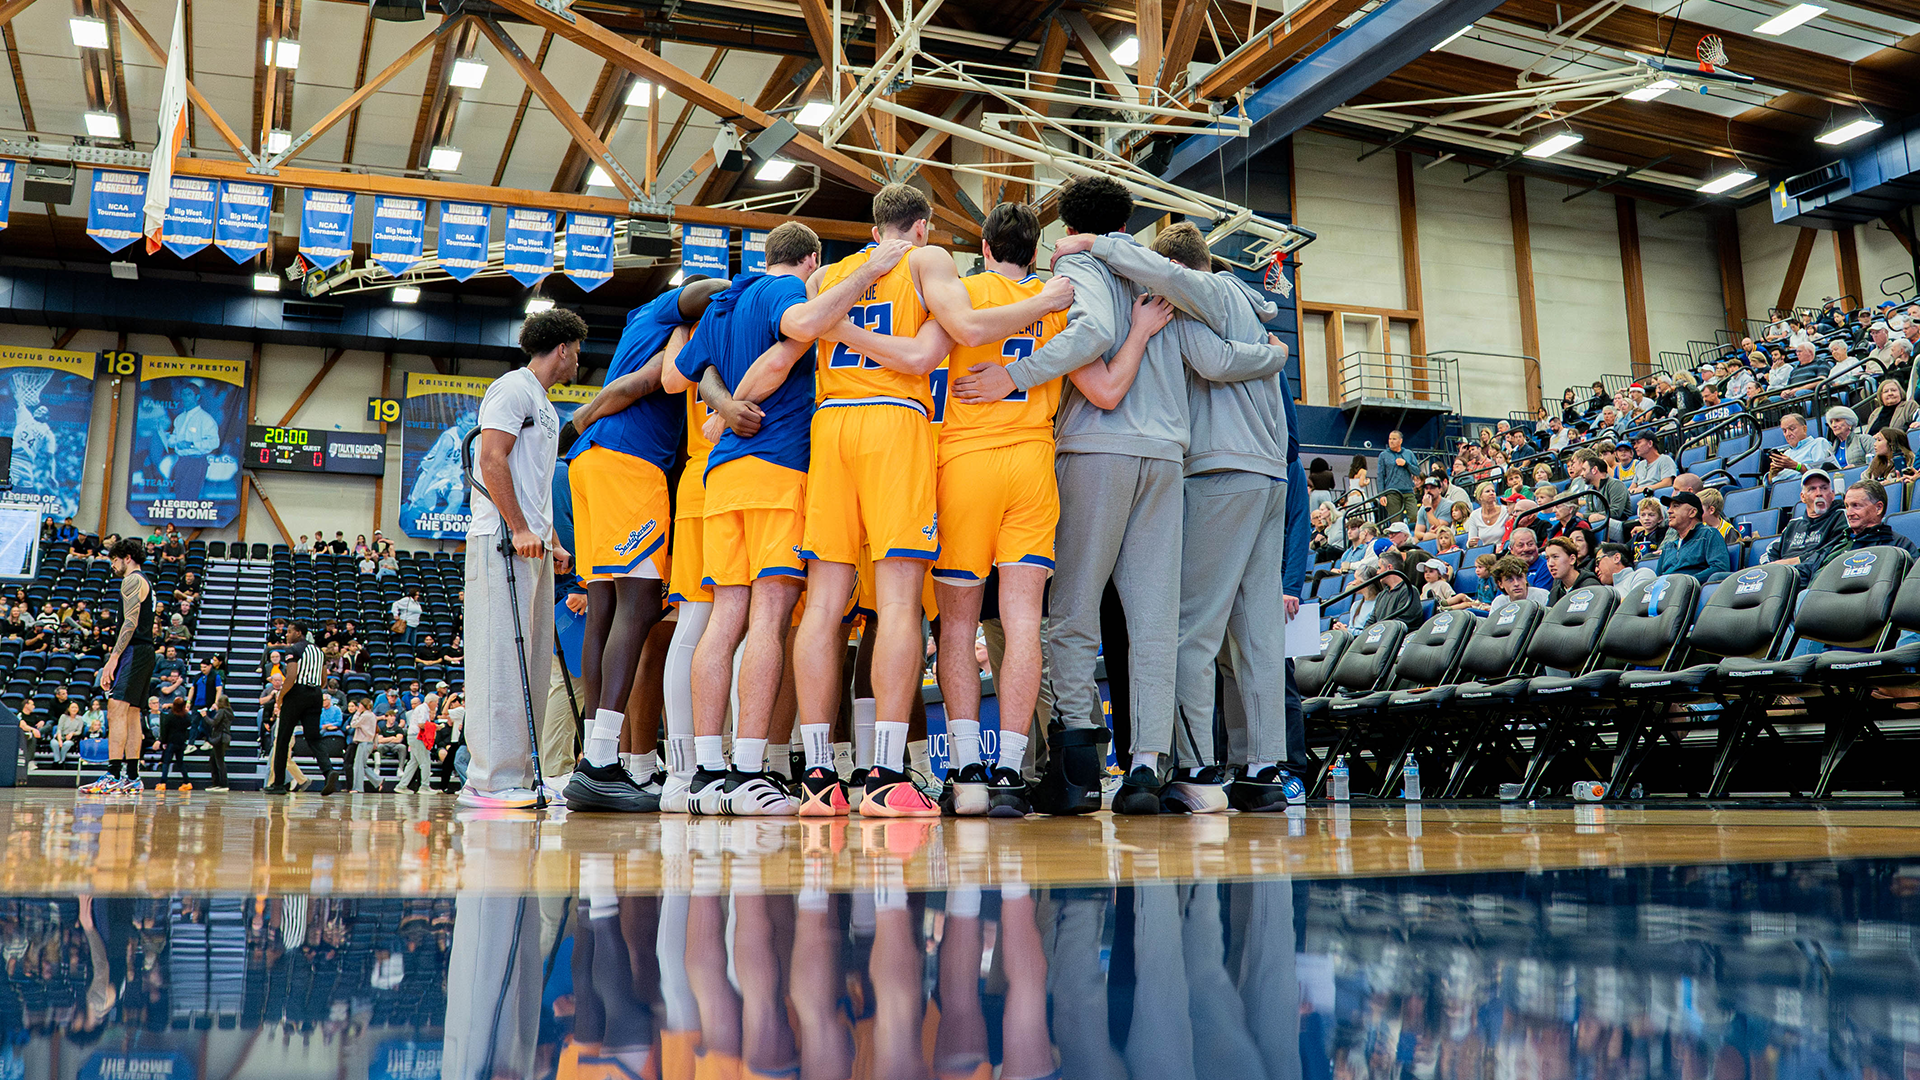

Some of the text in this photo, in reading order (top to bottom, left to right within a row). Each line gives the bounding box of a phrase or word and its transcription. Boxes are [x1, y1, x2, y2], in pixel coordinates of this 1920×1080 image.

[94, 182, 144, 195] BASKETBALL
[221, 193, 269, 207] BASKETBALL
[108, 203, 129, 211] NCAA
[174, 208, 185, 216] Big
[305, 200, 353, 215] BASKETBALL
[97, 208, 136, 218] Tournament
[230, 213, 241, 221] Big
[376, 207, 423, 221] BASKETBALL
[164, 214, 212, 225] Championships
[219, 218, 267, 230] Championships
[319, 221, 338, 229] NCAA
[442, 213, 488, 227] BASKETBALL
[508, 218, 553, 232] BASKETBALL
[98, 228, 131, 240] 1998
[308, 227, 346, 237] Tournament
[385, 226, 396, 235] Big
[568, 224, 612, 237] BASKETBALL
[169, 234, 202, 245] 1998
[375, 232, 422, 243] Championships
[455, 233, 475, 242] NCAA
[517, 237, 528, 246] Big
[684, 235, 728, 248] BASKETBALL
[225, 239, 257, 250] 1999
[446, 239, 482, 249] Tournament
[507, 244, 552, 255] Championships
[582, 244, 600, 252] NCAA
[310, 246, 341, 257] 1999
[572, 250, 607, 259] Tournament
[380, 252, 414, 263] 2000
[445, 257, 480, 269] 2000
[693, 254, 703, 262] Big
[514, 263, 544, 274] 2001
[684, 260, 727, 270] Championships
[573, 268, 603, 280] 2001
[2, 352, 82, 364] LUCIUS DAVIS
[103, 352, 135, 375] 18
[150, 361, 239, 372] KENNY PRESTON
[418, 379, 462, 388] KRISTEN
[143, 400, 180, 410] FAMILY
[370, 398, 399, 422] 19
[1705, 407, 1730, 420] UCSB
[406, 420, 435, 429] SWEET
[264, 428, 308, 445] 20:00
[250, 441, 267, 449] HOME
[260, 448, 270, 463] 0
[313, 451, 322, 467] 0
[138, 478, 176, 488] STEADY
[3, 492, 56, 503] LEGEND OF
[162, 500, 199, 508] LEGEND
[148, 507, 218, 520] THE DOME
[429, 513, 464, 522] LEGEND
[415, 519, 440, 531] THE
[1831, 660, 1882, 669] UCSBgauchos.com
[1729, 669, 1773, 677] UCSBgauchos.com
[928, 729, 997, 758] UCH ND
